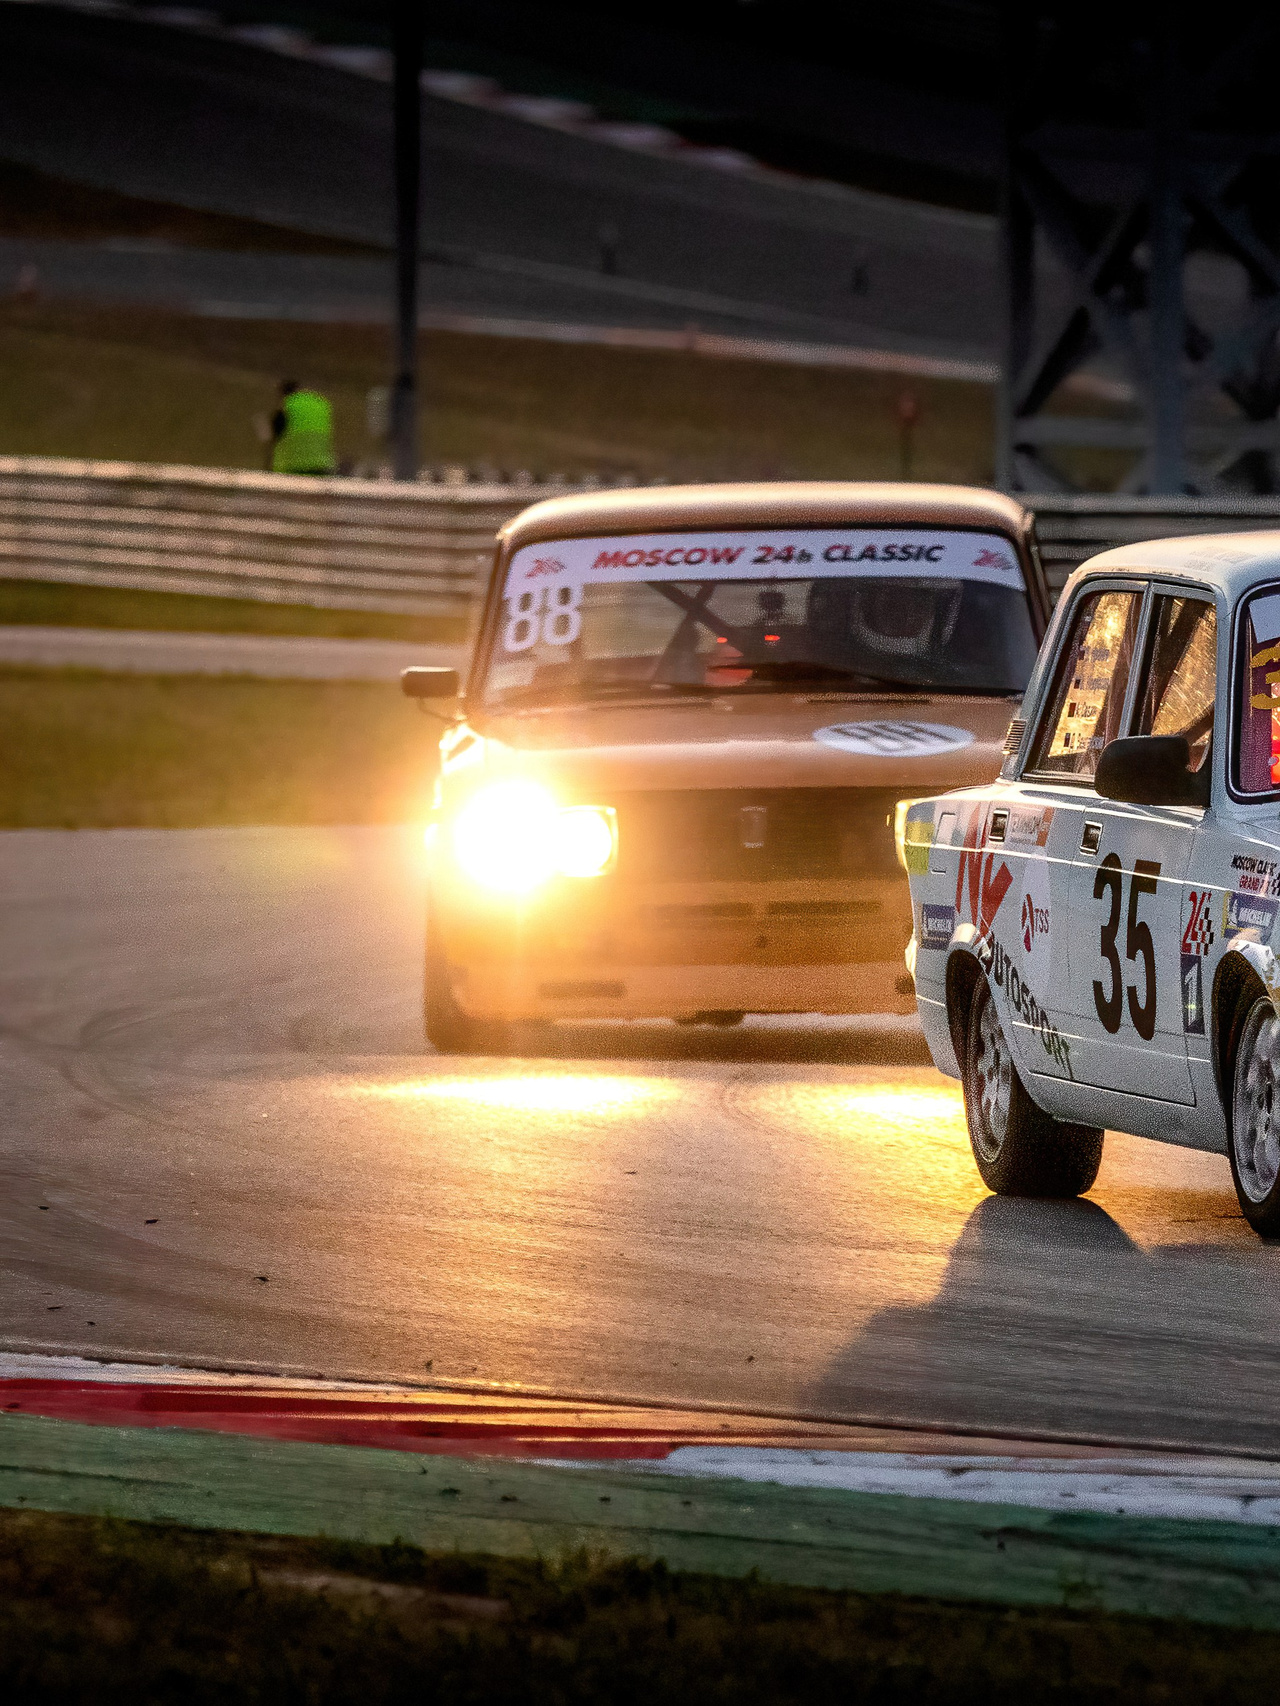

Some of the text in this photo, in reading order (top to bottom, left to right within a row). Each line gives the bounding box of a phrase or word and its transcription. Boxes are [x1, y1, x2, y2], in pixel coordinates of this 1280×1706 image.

[591, 547, 746, 569] MOSCOW
[822, 544, 946, 564] CLASSIC
[503, 583, 583, 652] 88
[1034, 908, 1049, 933] TSS
[1093, 852, 1162, 1042] 35
